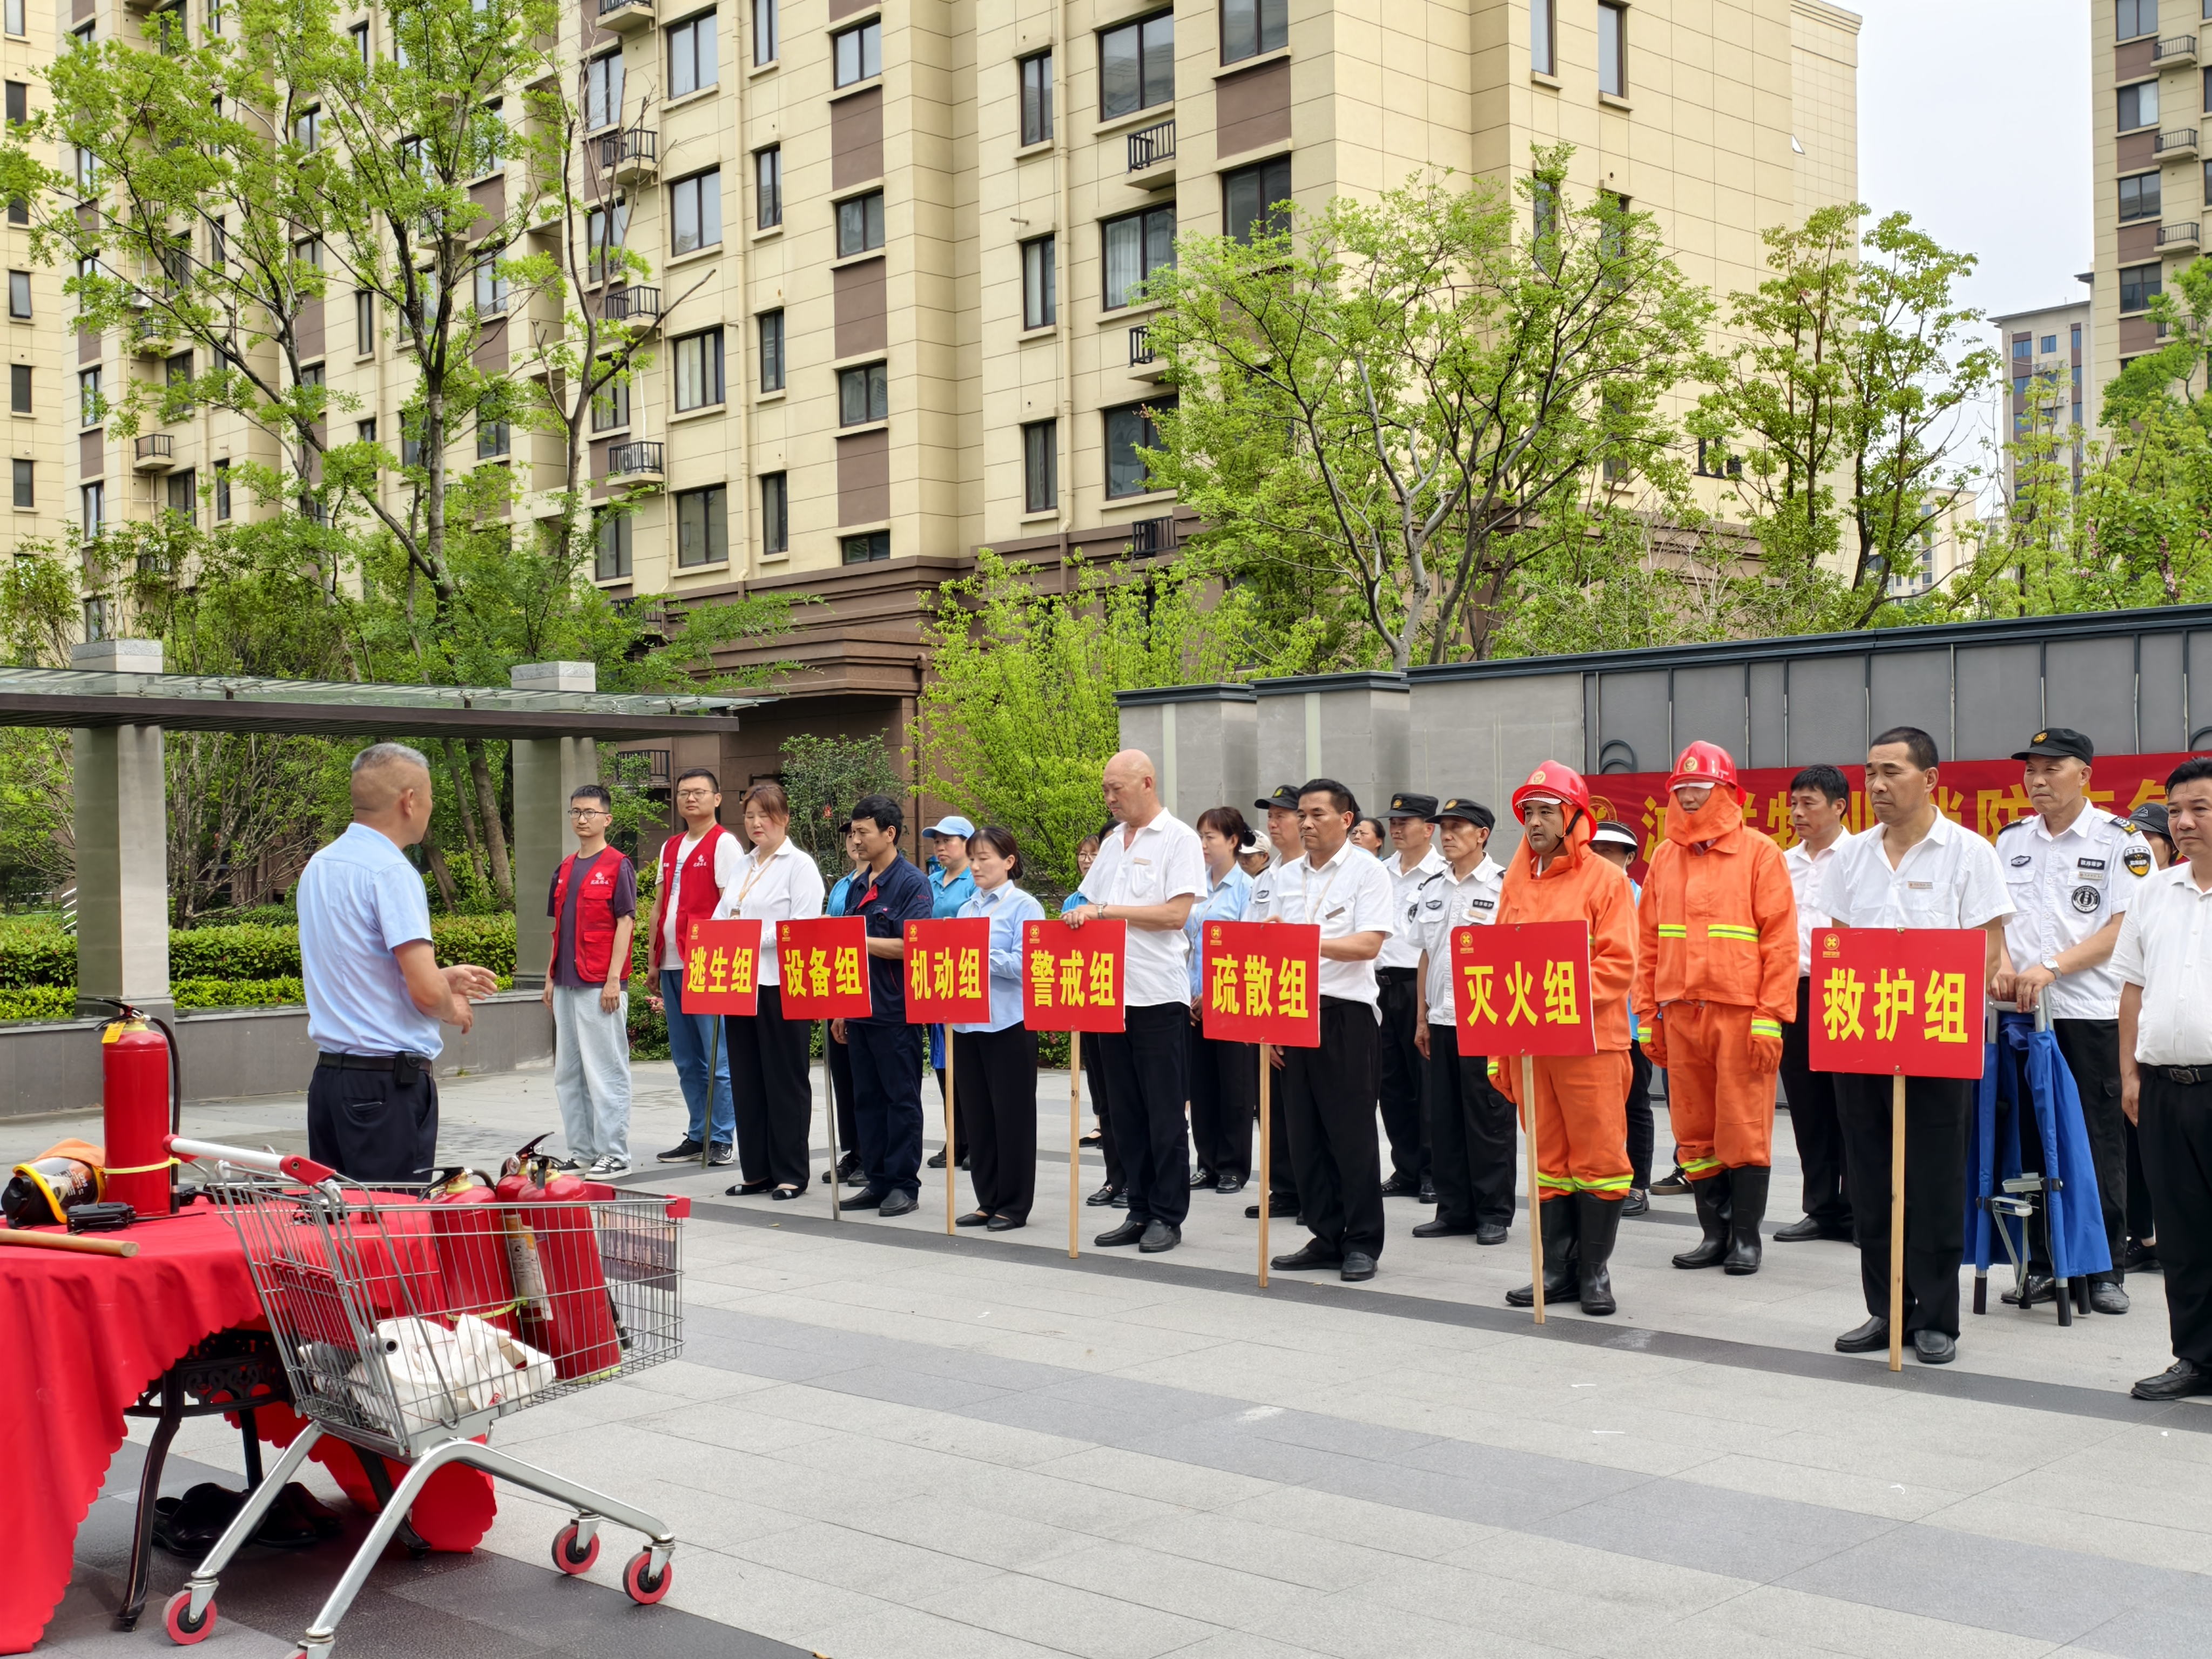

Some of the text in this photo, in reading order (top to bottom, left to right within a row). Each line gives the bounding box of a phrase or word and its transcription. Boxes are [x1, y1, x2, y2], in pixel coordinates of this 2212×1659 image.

[687, 946, 753, 993] 逃生组
[784, 946, 862, 997] 设备组
[911, 947, 982, 1000] 机动组
[1030, 949, 1116, 1007] 警戒组
[1211, 954, 1309, 1018] 疏散组
[1464, 959, 1580, 1027] 灭火组
[1823, 967, 1968, 1043] 救护组
